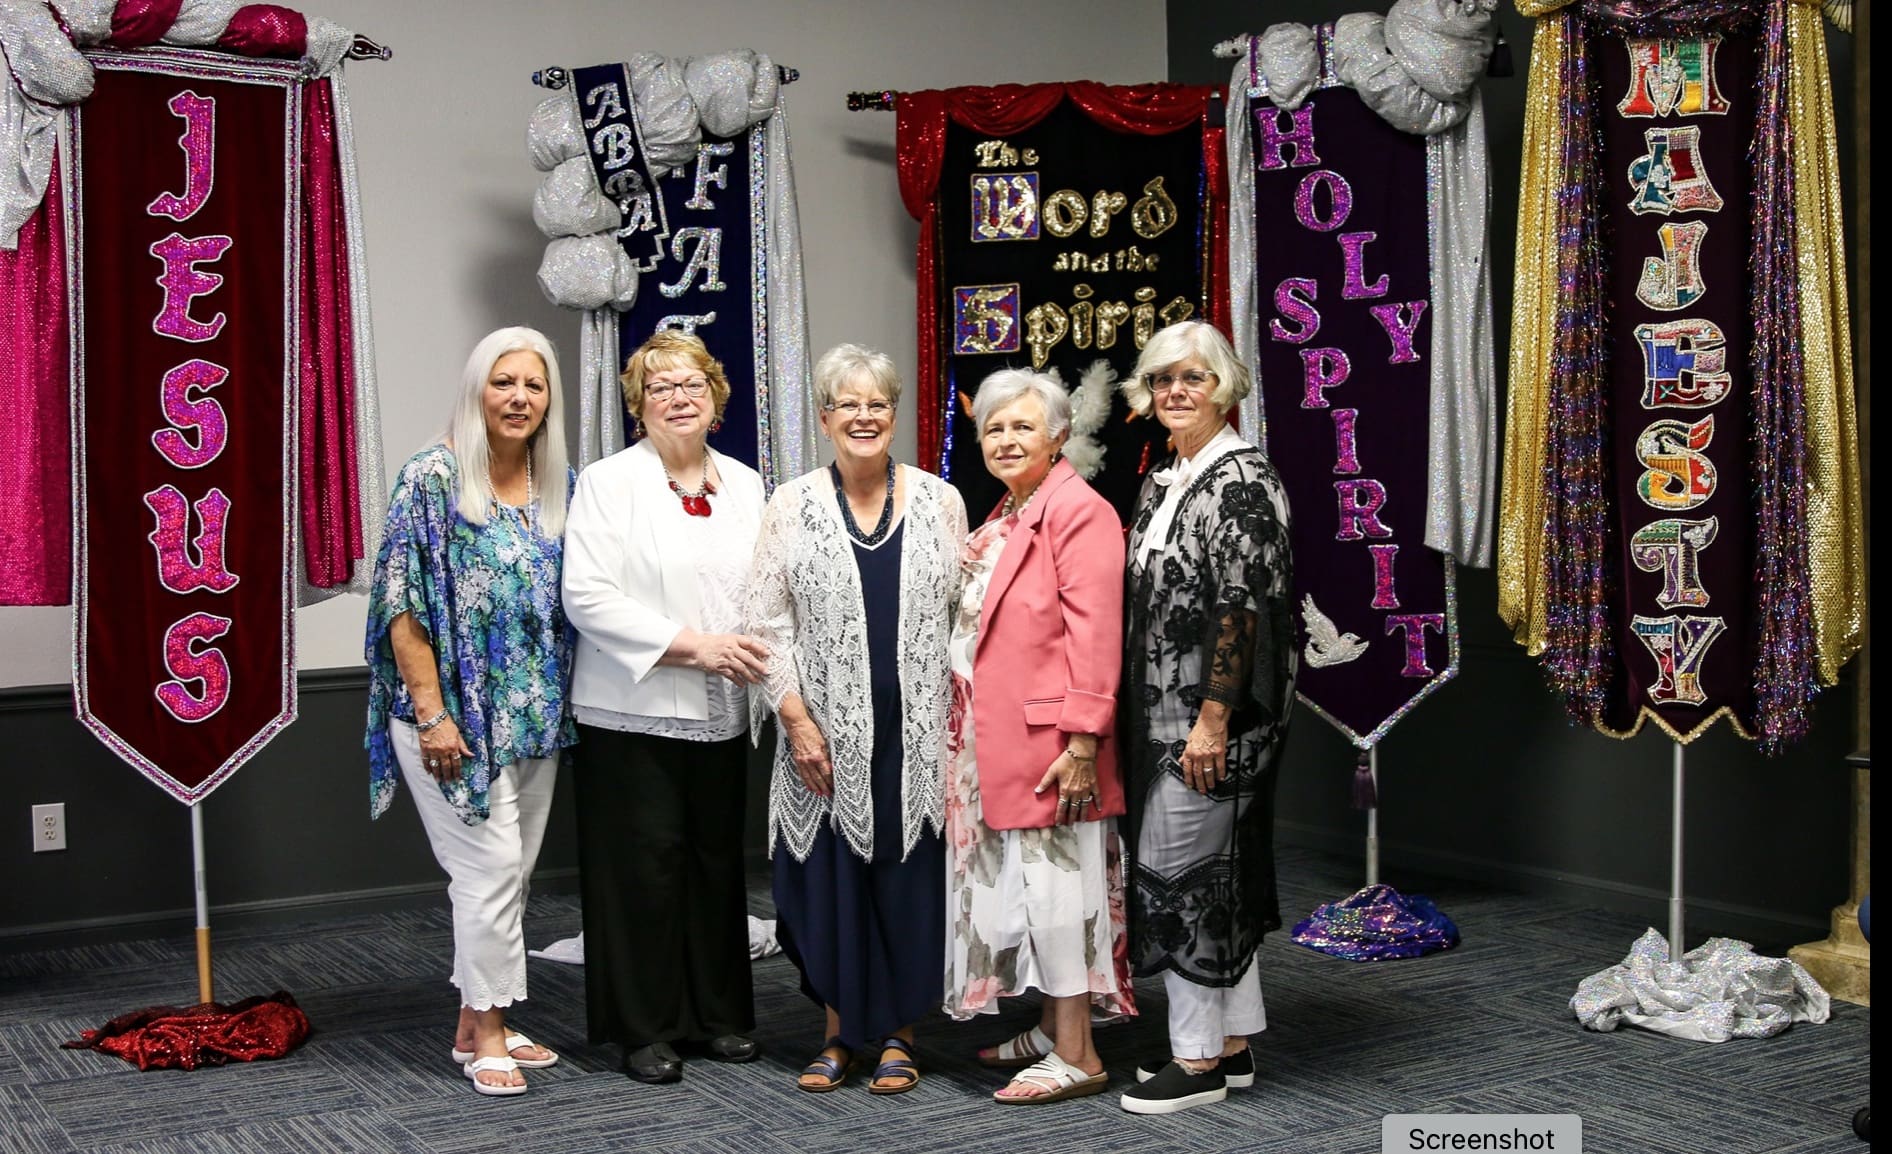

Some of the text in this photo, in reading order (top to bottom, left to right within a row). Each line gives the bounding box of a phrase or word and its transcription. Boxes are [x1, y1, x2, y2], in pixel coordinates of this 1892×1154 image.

[971, 171, 1178, 243] Word
[974, 140, 1040, 168] The
[1053, 245, 1160, 272] and the
[1255, 102, 1429, 365] HOLY
[143, 90, 240, 723] JESUS
[1269, 277, 1445, 678] SPIRIT
[1617, 36, 1731, 706] MAJESTY
